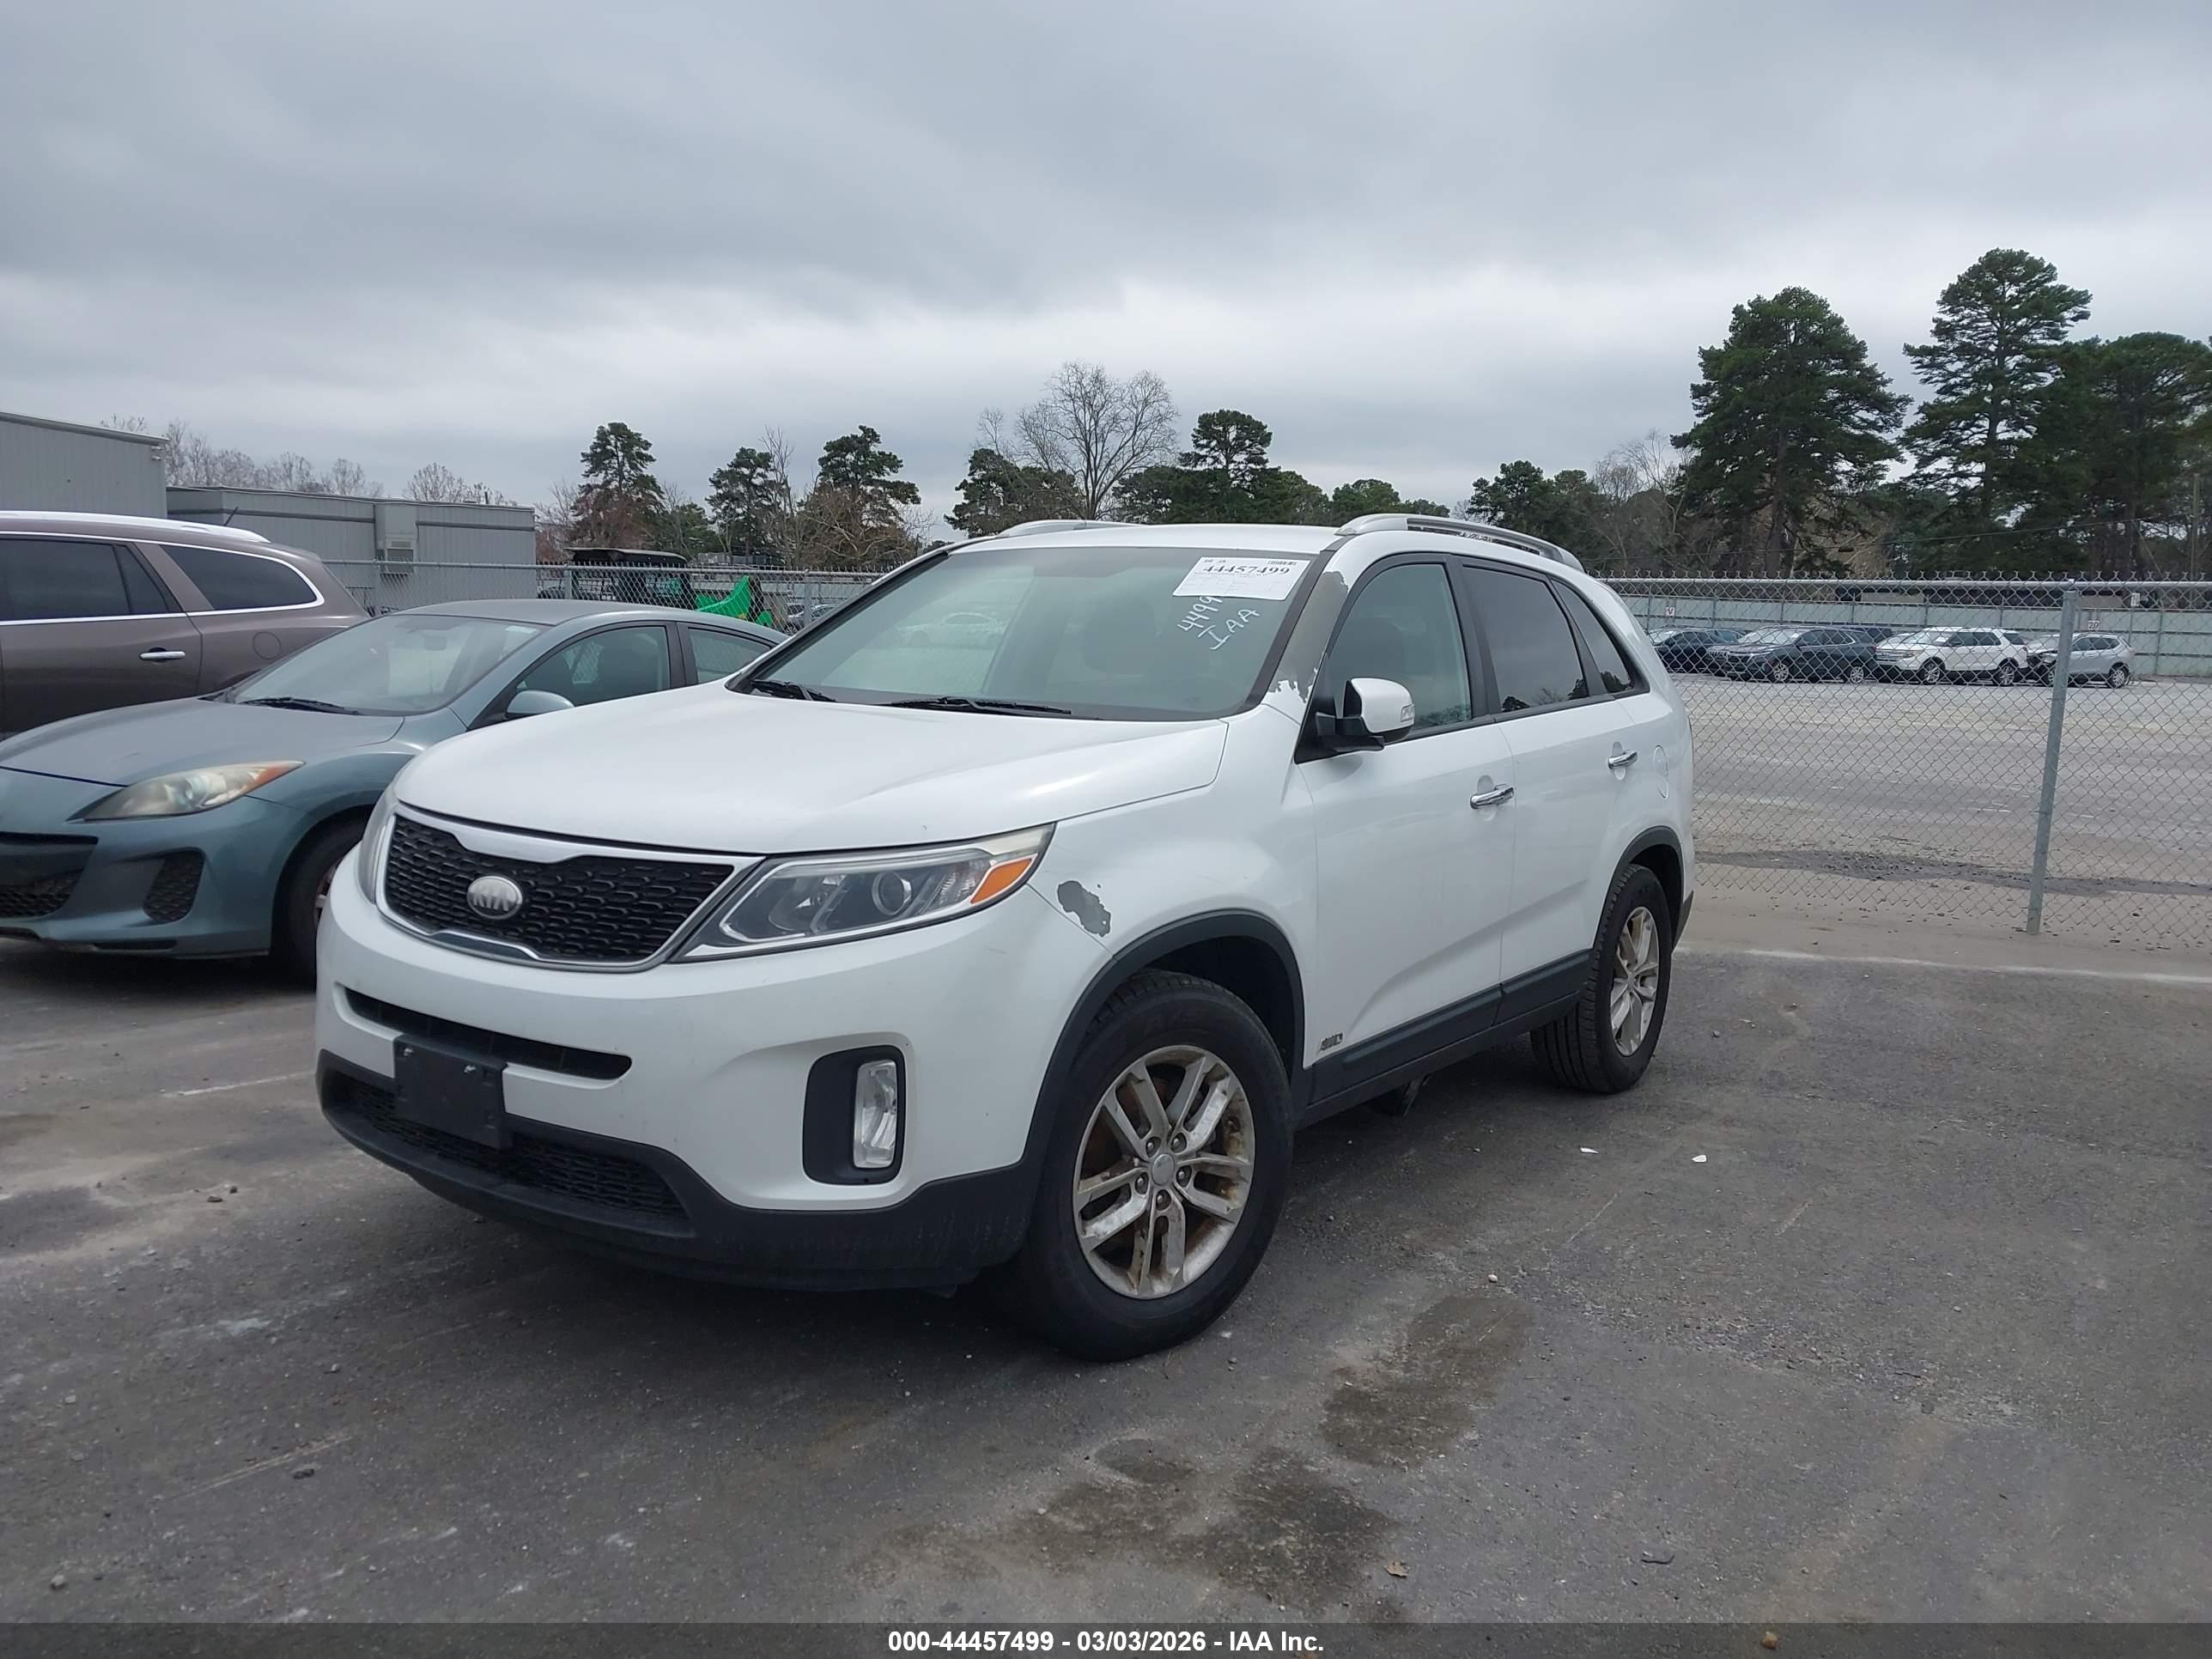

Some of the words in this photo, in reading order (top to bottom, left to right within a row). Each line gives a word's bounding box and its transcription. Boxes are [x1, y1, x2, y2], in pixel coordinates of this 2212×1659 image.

[1202, 565, 1291, 574] 44457499
[1197, 609, 1261, 651] IAA
[472, 885, 509, 912] KIA
